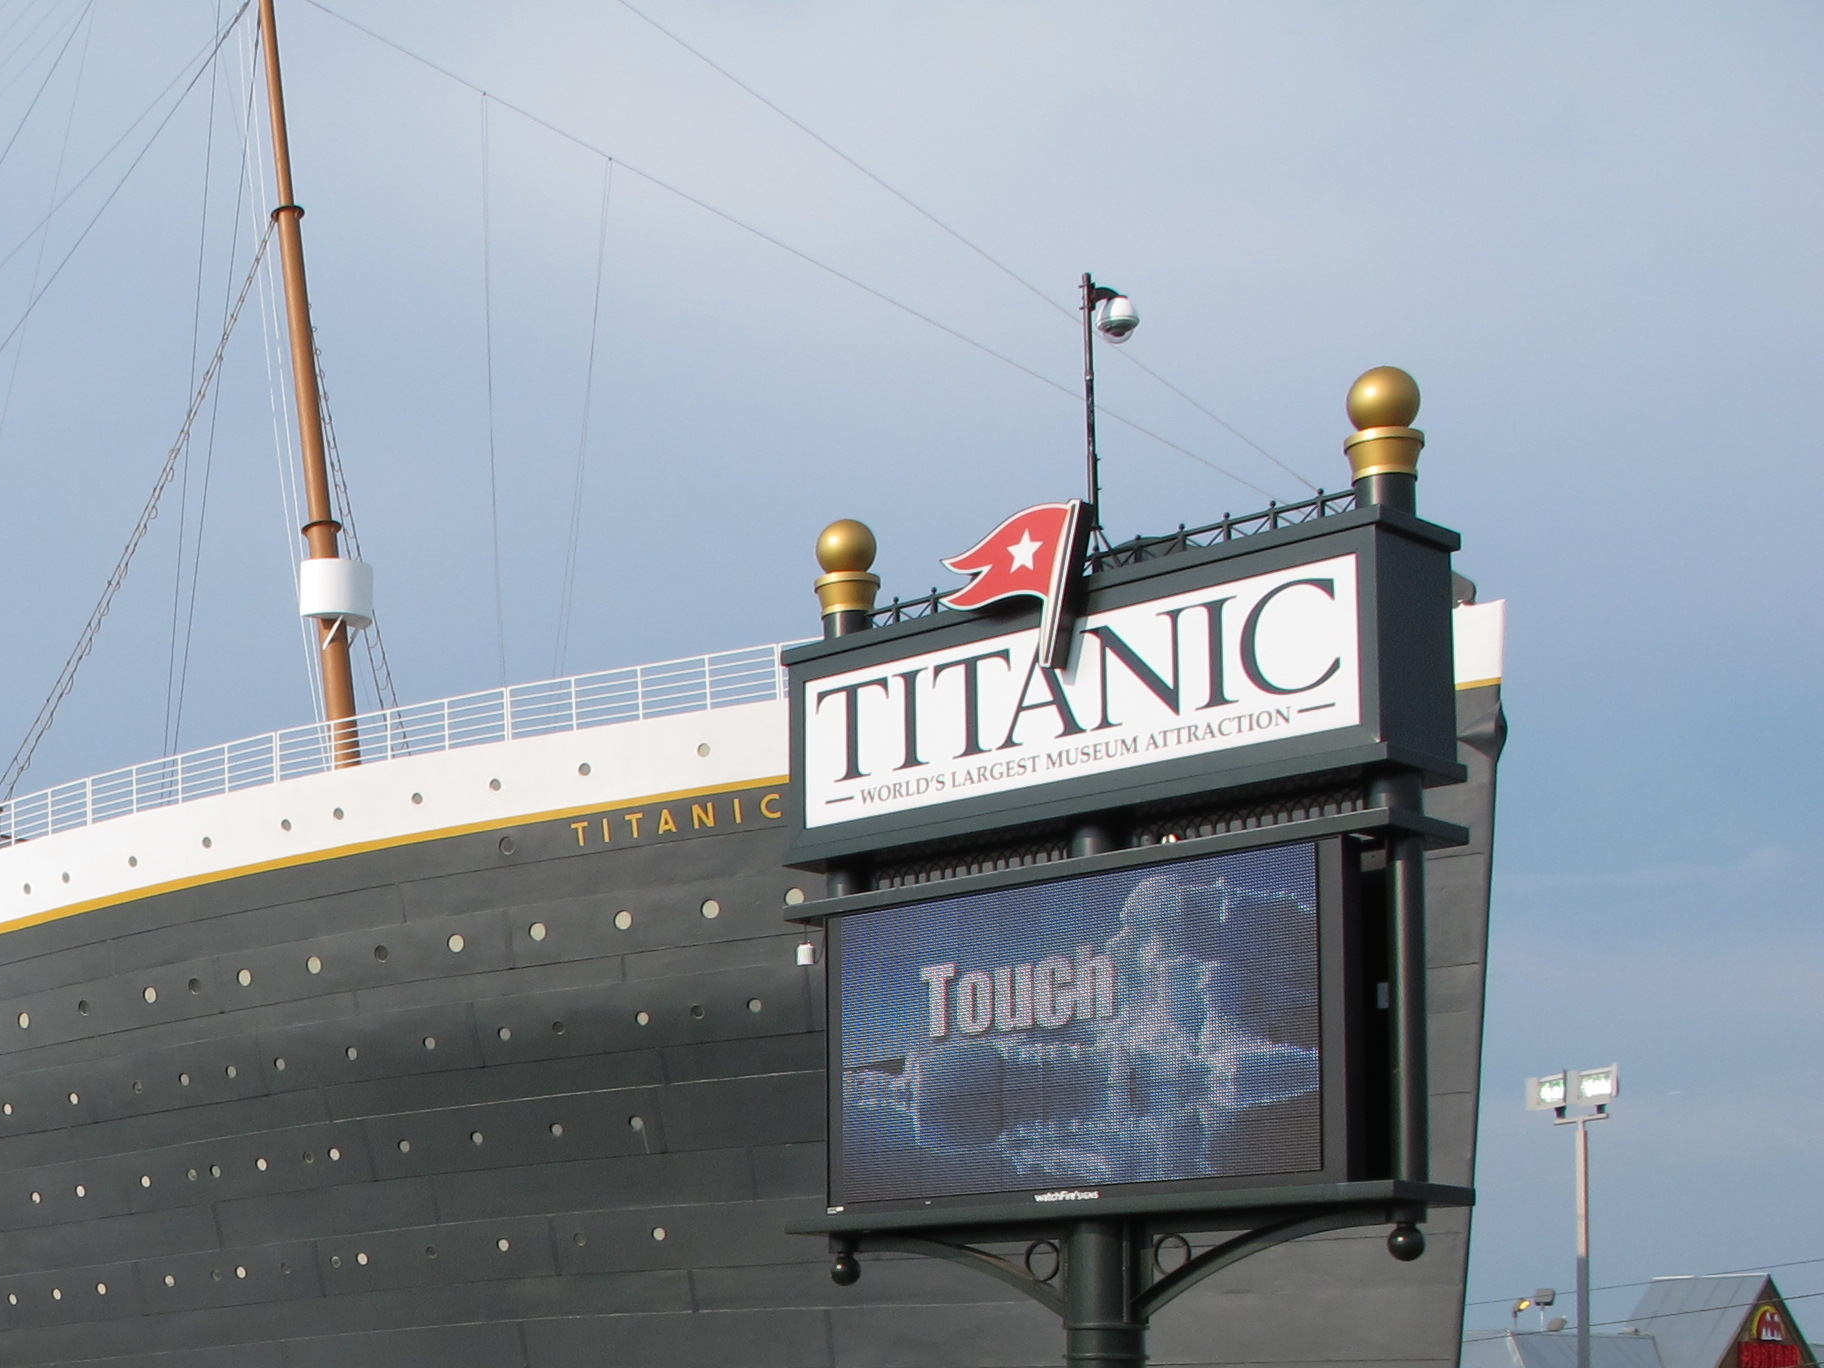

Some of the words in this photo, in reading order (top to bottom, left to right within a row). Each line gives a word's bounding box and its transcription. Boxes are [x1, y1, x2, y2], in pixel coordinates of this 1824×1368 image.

[816, 577, 1341, 783] TITANIC
[860, 773, 946, 805] WORLD'S
[951, 755, 1041, 789] LARGEST
[1044, 735, 1140, 770] MUSEUM
[1145, 706, 1292, 751] ATTRACTION
[570, 793, 783, 847] TITANIC
